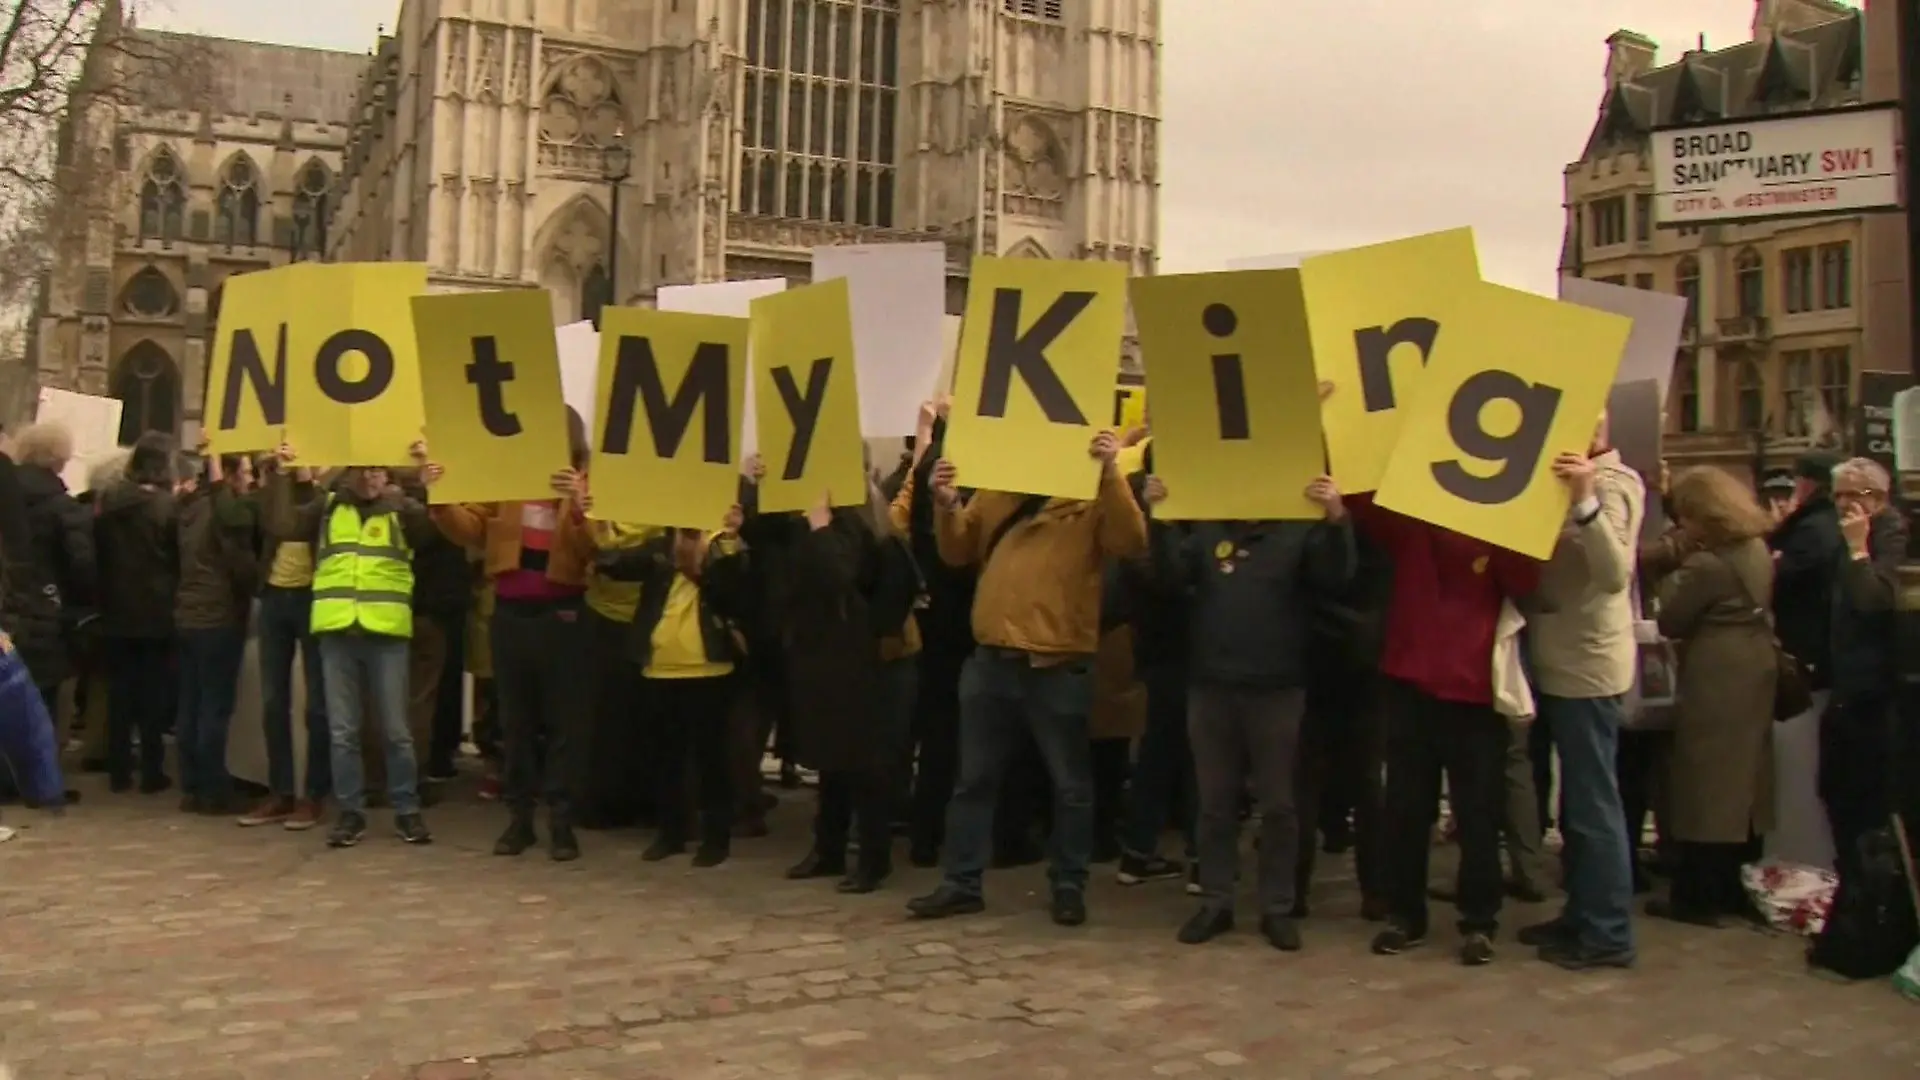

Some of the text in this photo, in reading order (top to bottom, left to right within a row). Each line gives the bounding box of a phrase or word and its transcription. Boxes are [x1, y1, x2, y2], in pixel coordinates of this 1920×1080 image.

[1673, 131, 1753, 158] BROAD
[1821, 148, 1874, 173] SW1
[1710, 195, 1725, 211] O
[219, 322, 524, 437] Not
[600, 334, 834, 481] My
